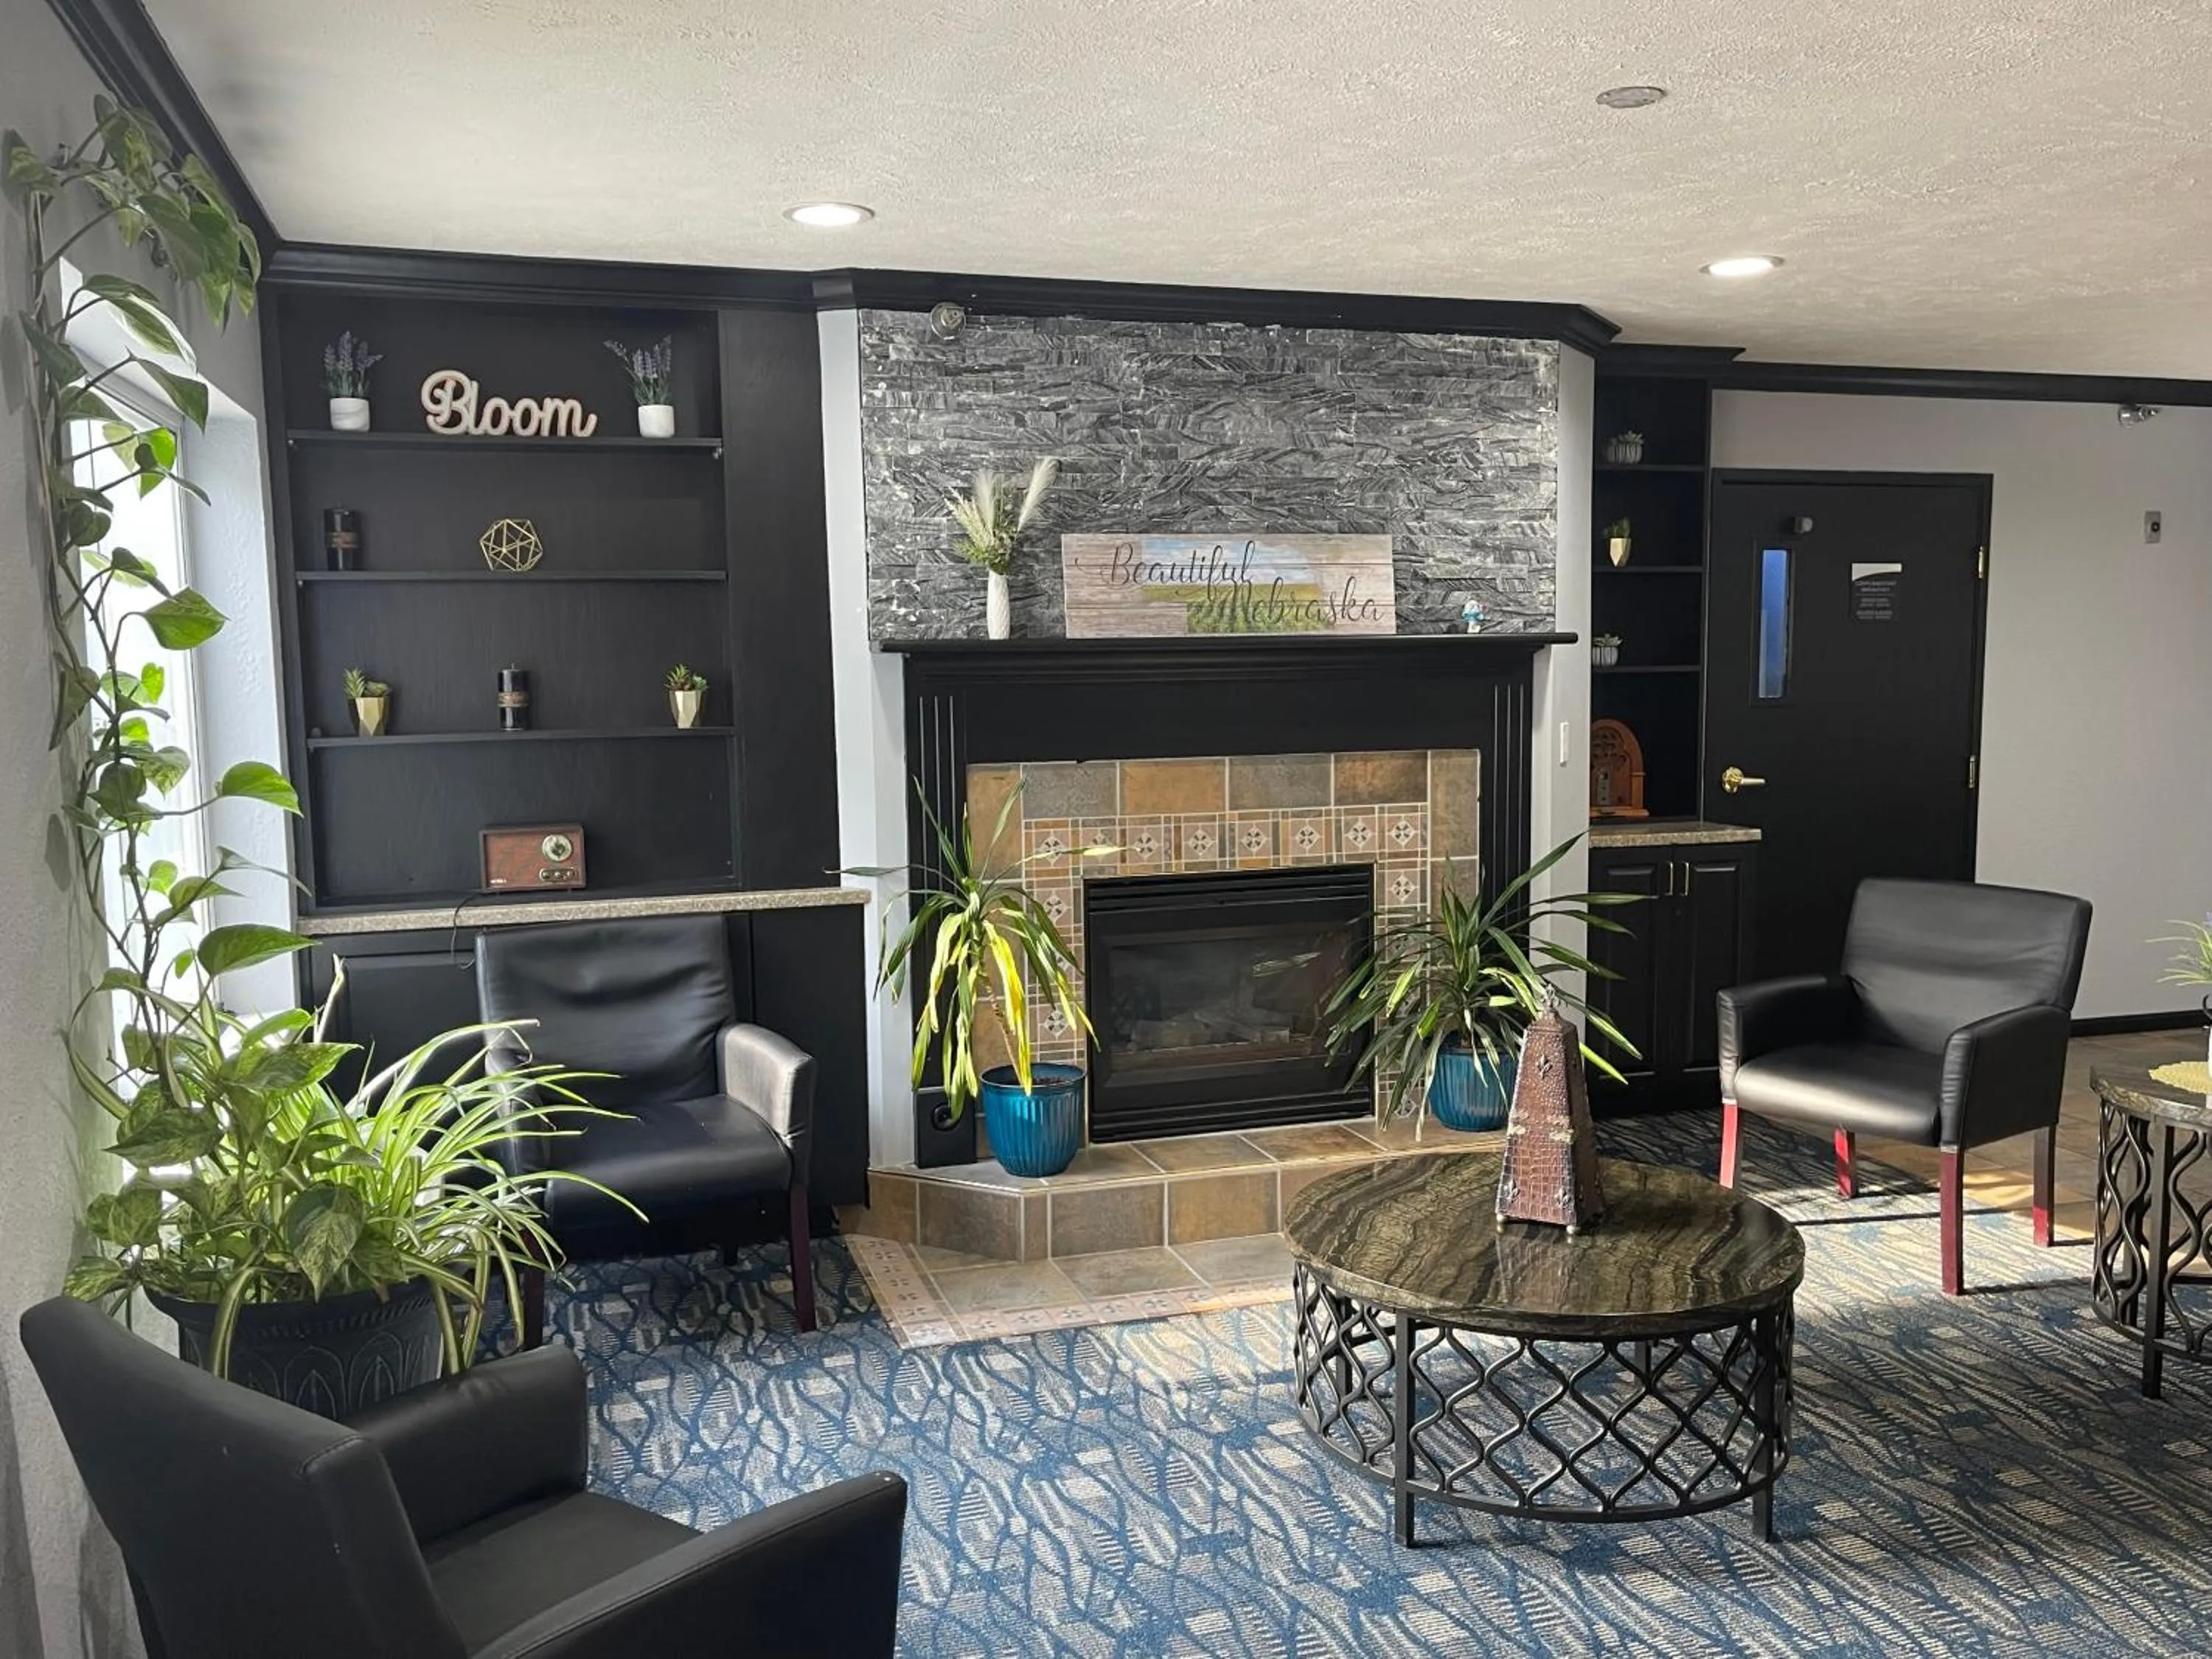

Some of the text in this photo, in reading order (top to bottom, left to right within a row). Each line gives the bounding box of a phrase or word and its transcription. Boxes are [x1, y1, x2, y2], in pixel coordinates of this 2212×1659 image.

[422, 369, 597, 437] Bloom
[1074, 540, 1255, 602] Beautiful
[1208, 576, 1384, 629] Nebraska
